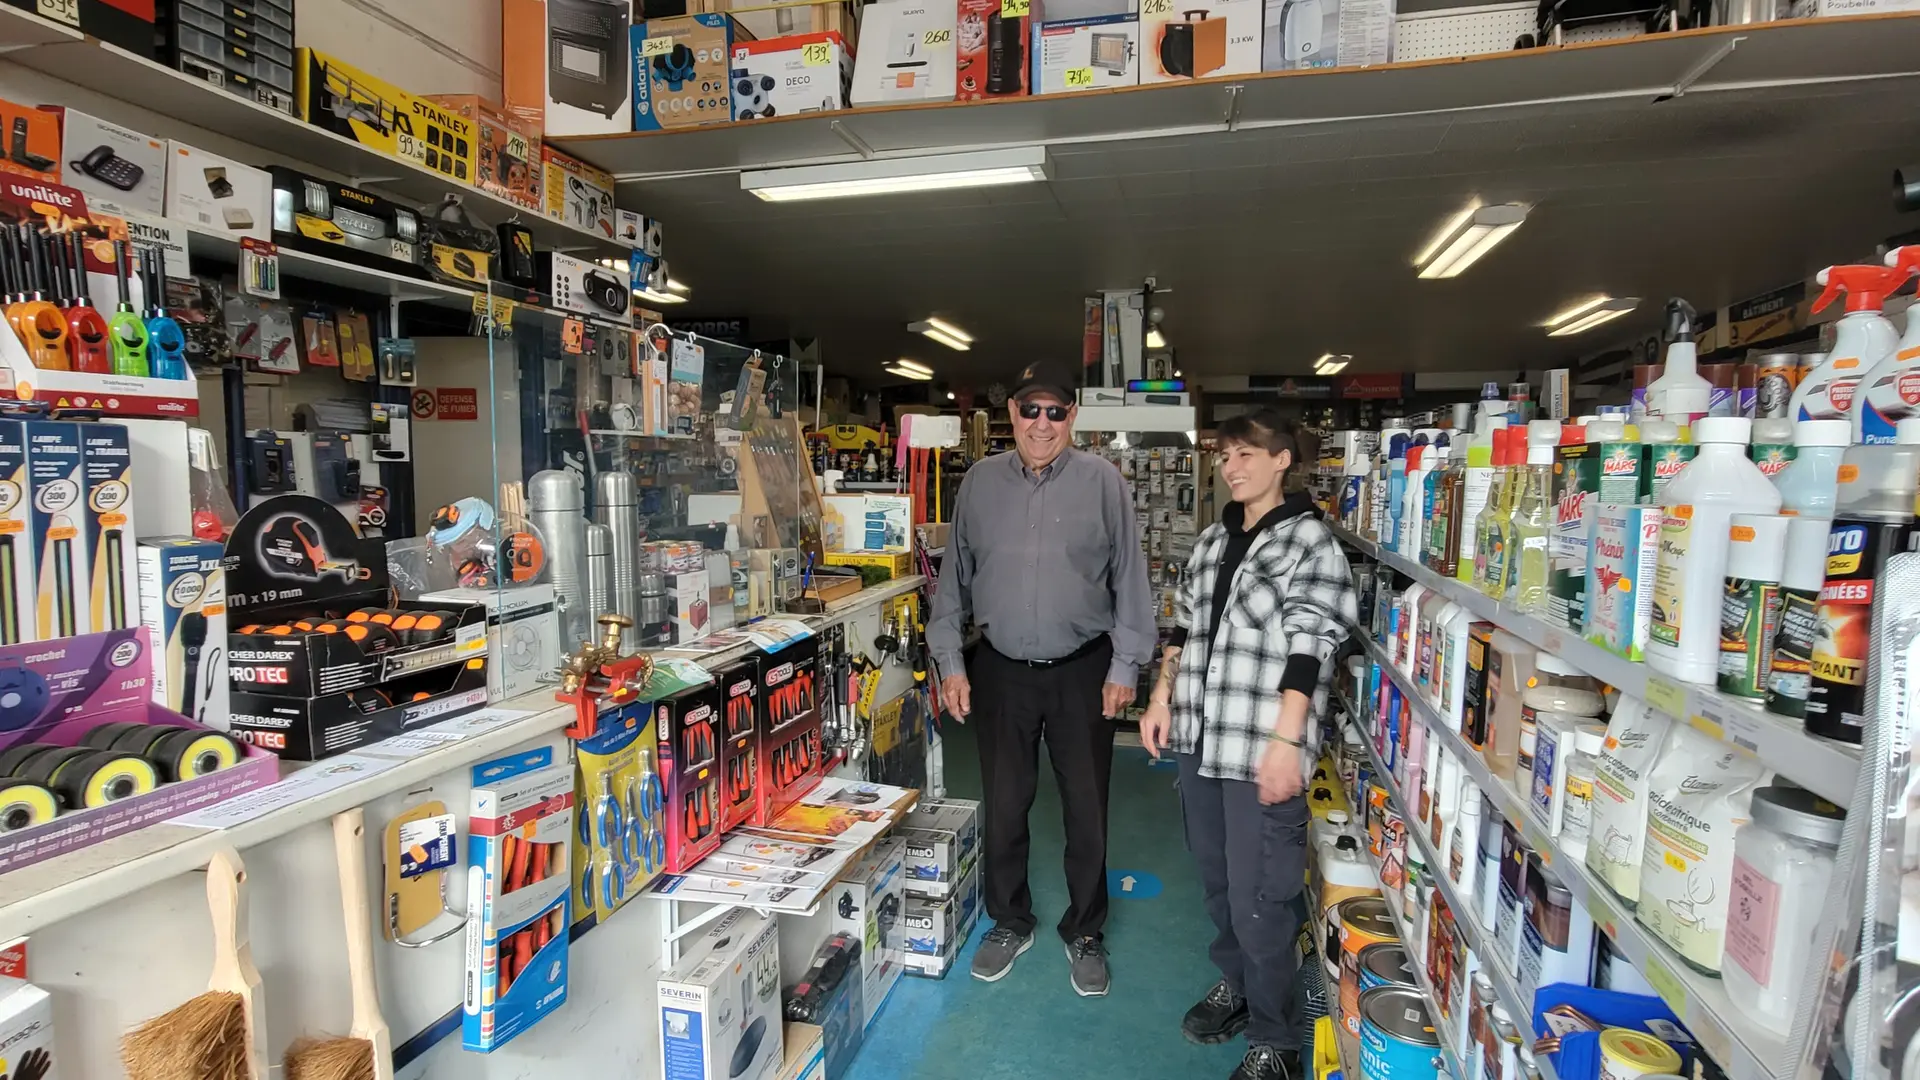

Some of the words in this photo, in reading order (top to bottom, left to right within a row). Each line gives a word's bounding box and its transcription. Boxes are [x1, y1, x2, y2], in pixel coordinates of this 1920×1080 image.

[786, 75, 811, 87] DECO
[412, 101, 468, 136] STANLEY
[10, 183, 73, 208] unilite
[341, 188, 375, 205] STANLEY
[127, 221, 169, 241] ENTION
[439, 404, 450, 413] DE
[452, 404, 476, 415] FUMER
[32, 435, 62, 443] LAMPE
[1866, 434, 1896, 445] Puna
[1604, 459, 1637, 474] MARC
[1759, 461, 1789, 476] MAR
[47, 492, 66, 500] 300
[1557, 492, 1586, 523] MARC
[251, 595, 259, 604] x
[261, 590, 277, 602] 19
[279, 588, 303, 600] mm
[1820, 583, 1867, 600] GNÉES
[25, 649, 66, 664] crochet
[116, 650, 132, 659] 200
[228, 650, 255, 660] CHER
[256, 650, 294, 661] DAREX
[61, 677, 79, 689] vis
[121, 678, 146, 690] 1h30
[230, 713, 256, 725] CHER
[258, 714, 292, 727] DAREX
[709, 908, 742, 938] SEVERIN
[748, 920, 778, 959] SEVERIN
[661, 988, 702, 1000] SEVERIN
